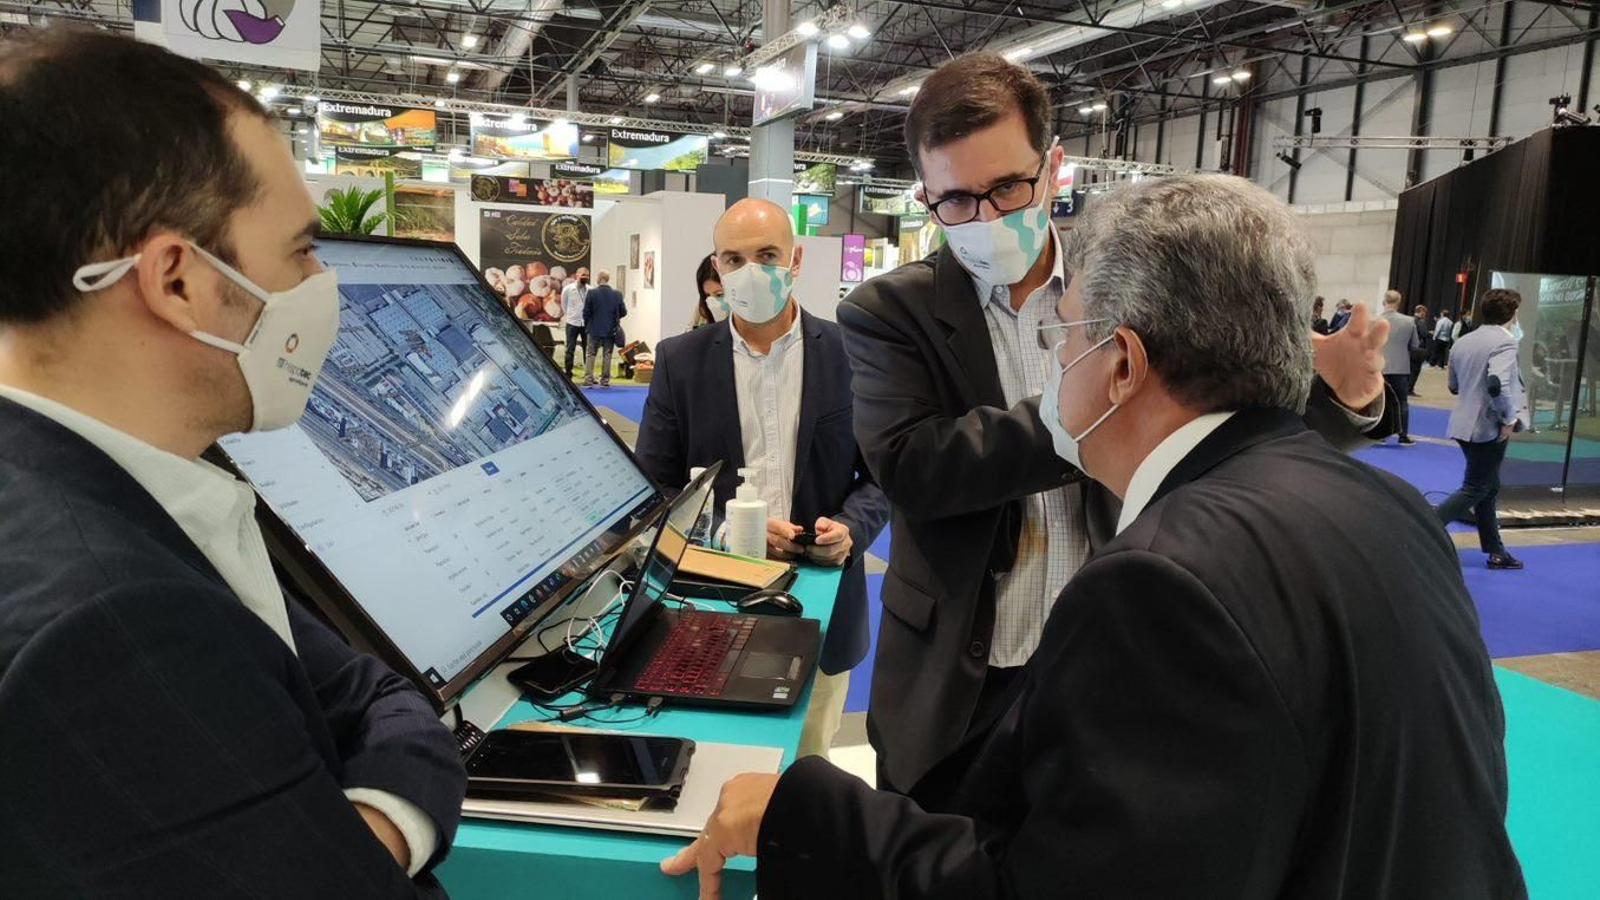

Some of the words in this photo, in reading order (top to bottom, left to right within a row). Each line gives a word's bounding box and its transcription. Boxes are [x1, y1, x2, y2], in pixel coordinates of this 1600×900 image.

[323, 102, 392, 117] Extremadura
[611, 129, 670, 143] Extremadura
[555, 163, 601, 174] Extremadura
